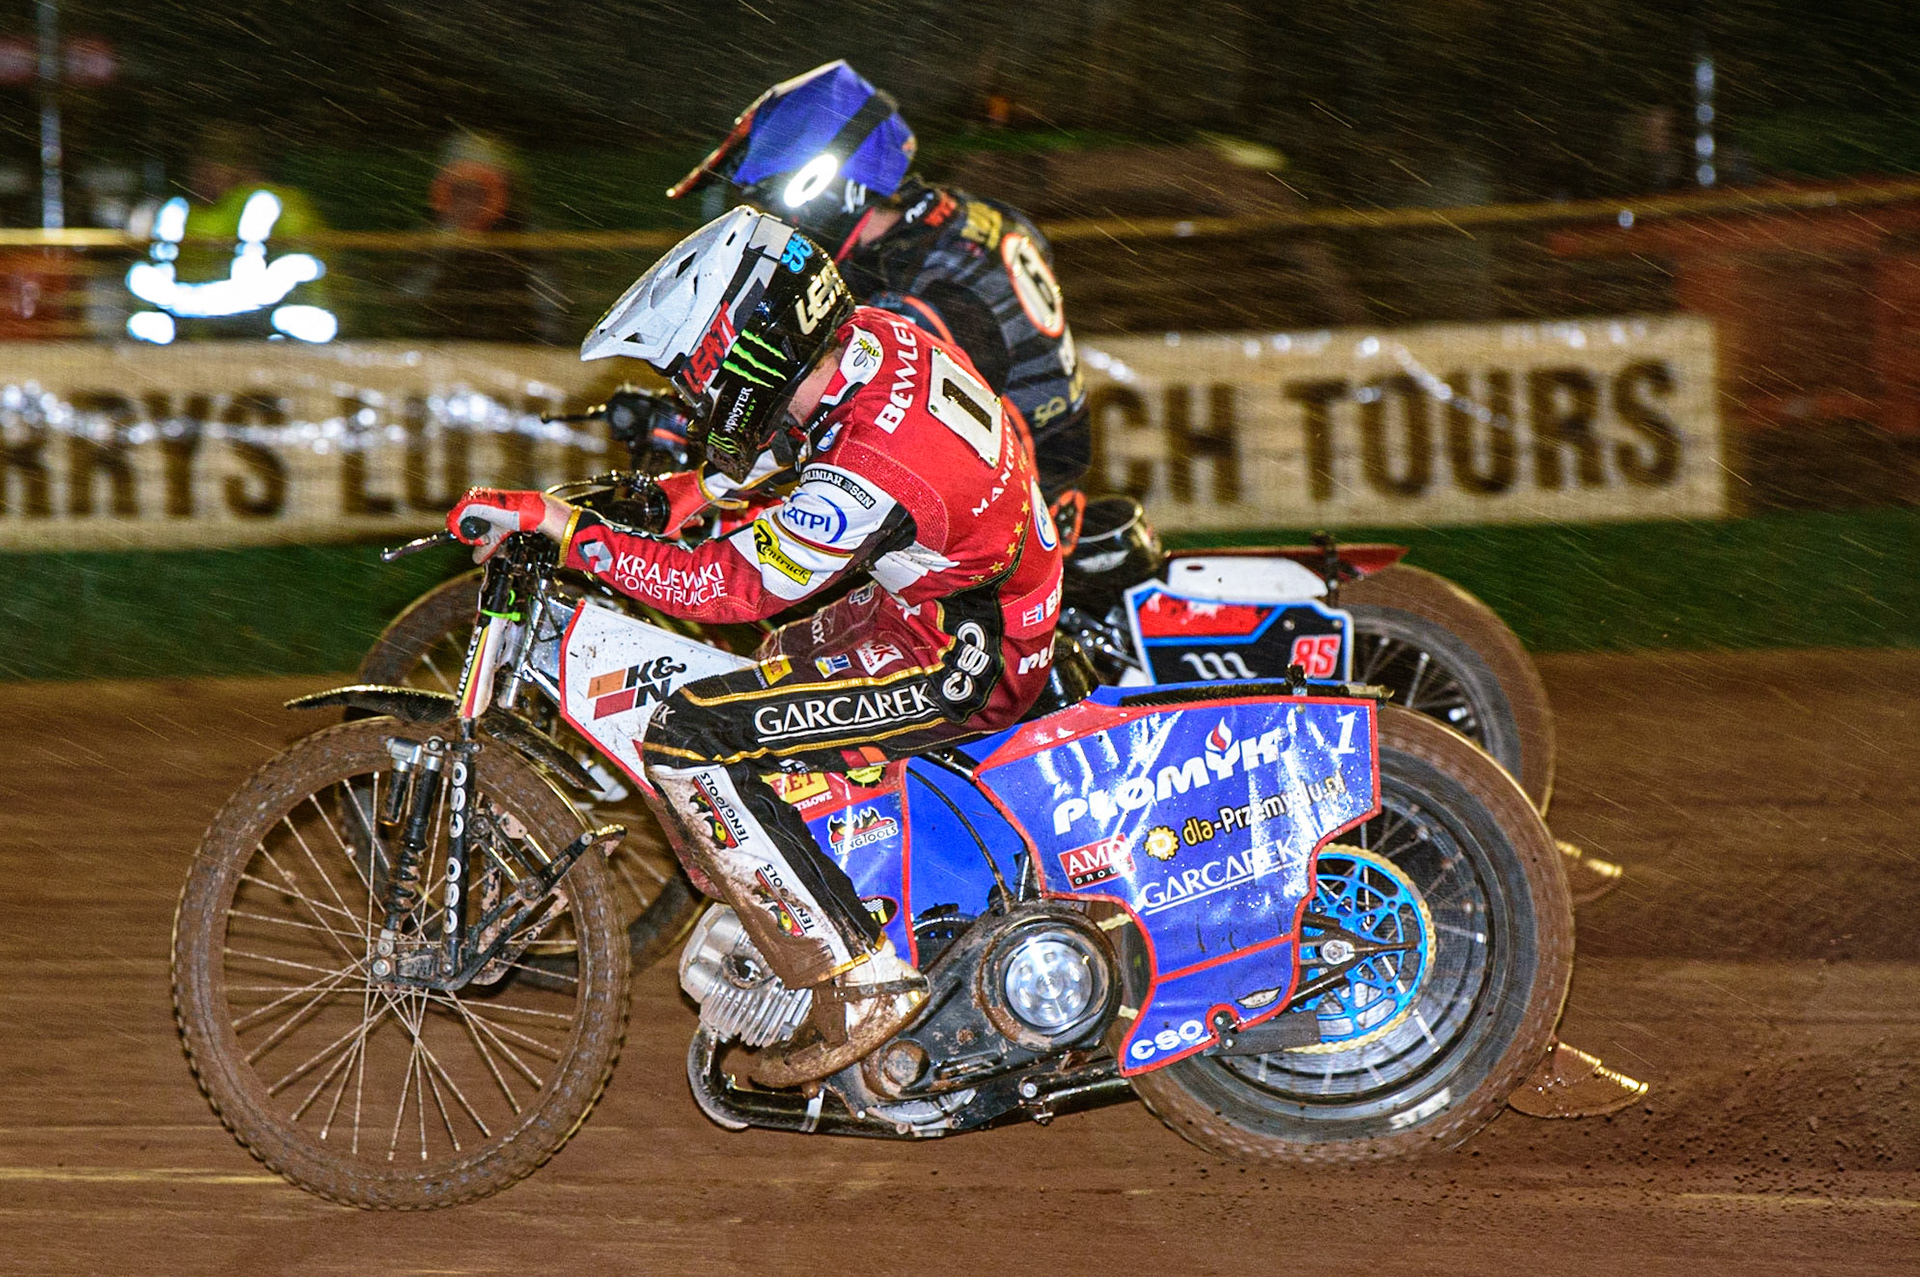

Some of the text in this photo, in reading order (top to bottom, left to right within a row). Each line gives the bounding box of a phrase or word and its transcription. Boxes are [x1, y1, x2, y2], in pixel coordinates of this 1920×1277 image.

[874, 320, 919, 435] BEWLE
[1283, 357, 1684, 500] TOURS
[1292, 634, 1342, 679] 85
[754, 683, 941, 735] GARCAREK
